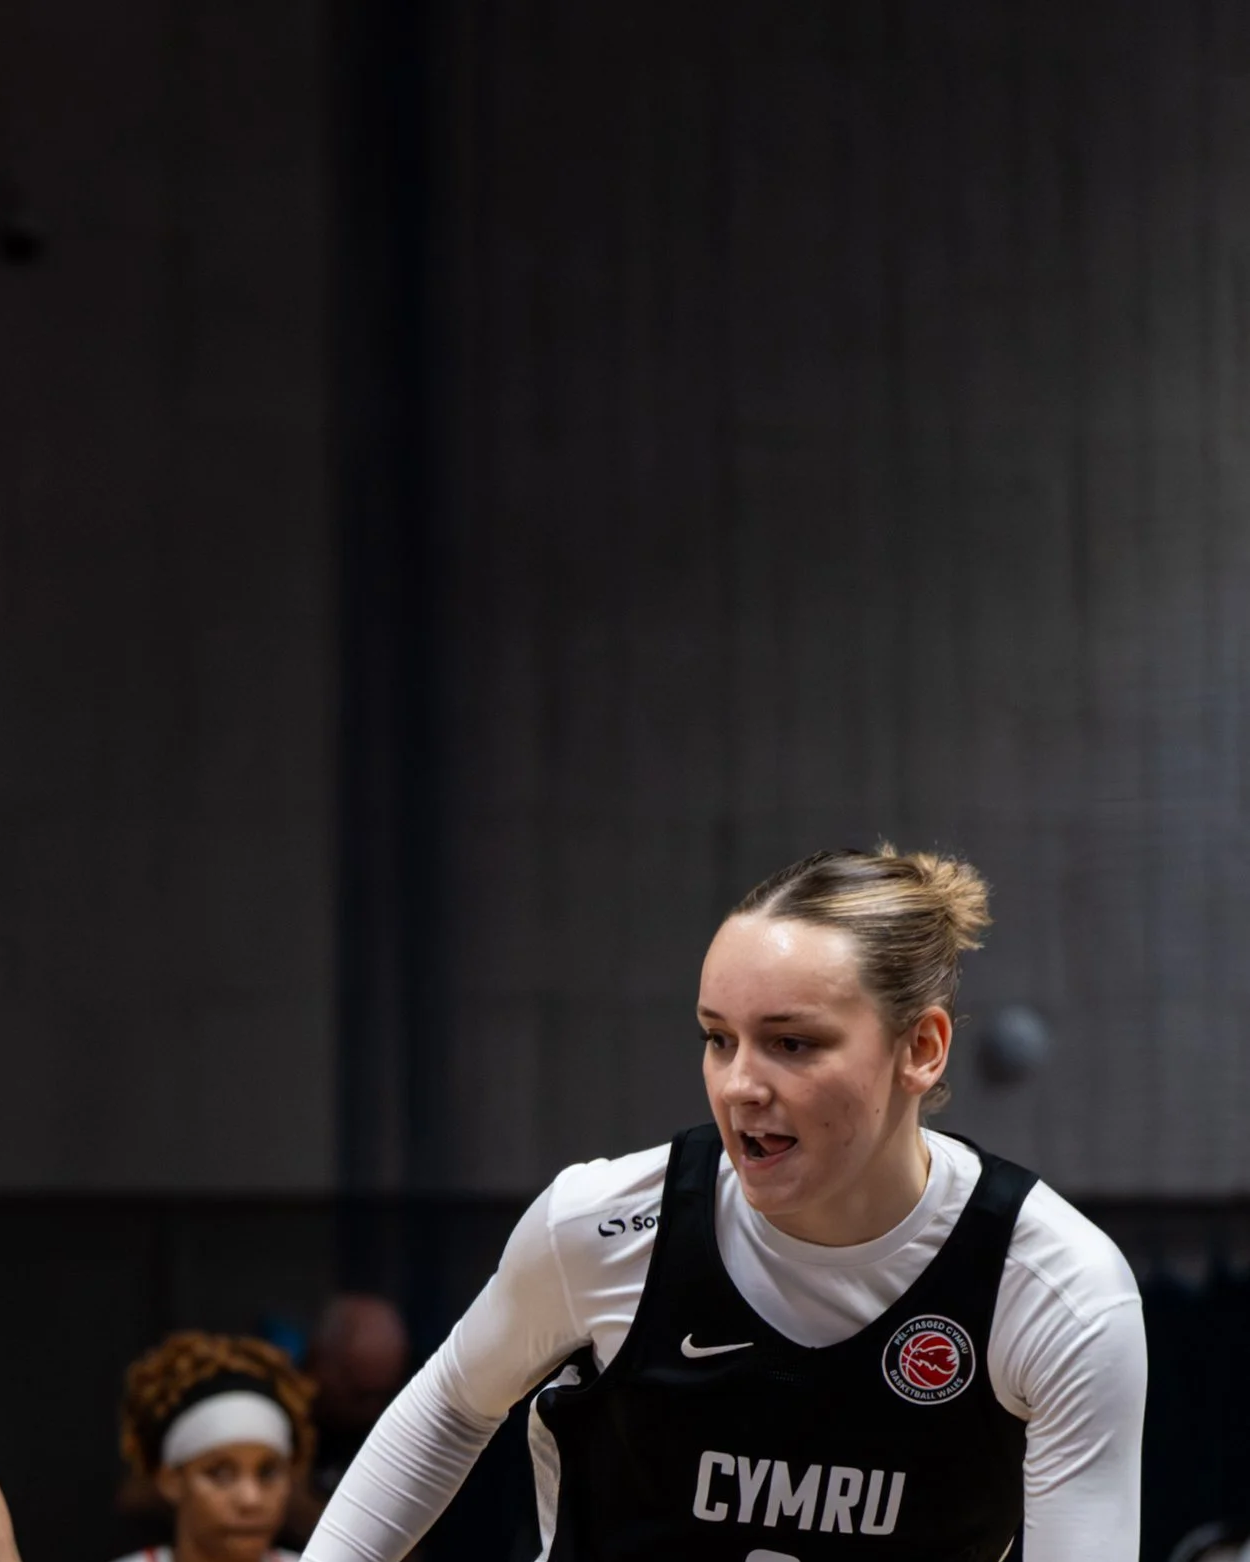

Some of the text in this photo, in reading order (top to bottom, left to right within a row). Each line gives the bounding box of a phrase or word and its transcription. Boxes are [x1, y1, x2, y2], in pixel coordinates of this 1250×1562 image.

[945, 1326, 969, 1354] CYMRU
[889, 1369, 964, 1400] BASKETBALL WALES
[692, 1450, 906, 1536] CYMRU
